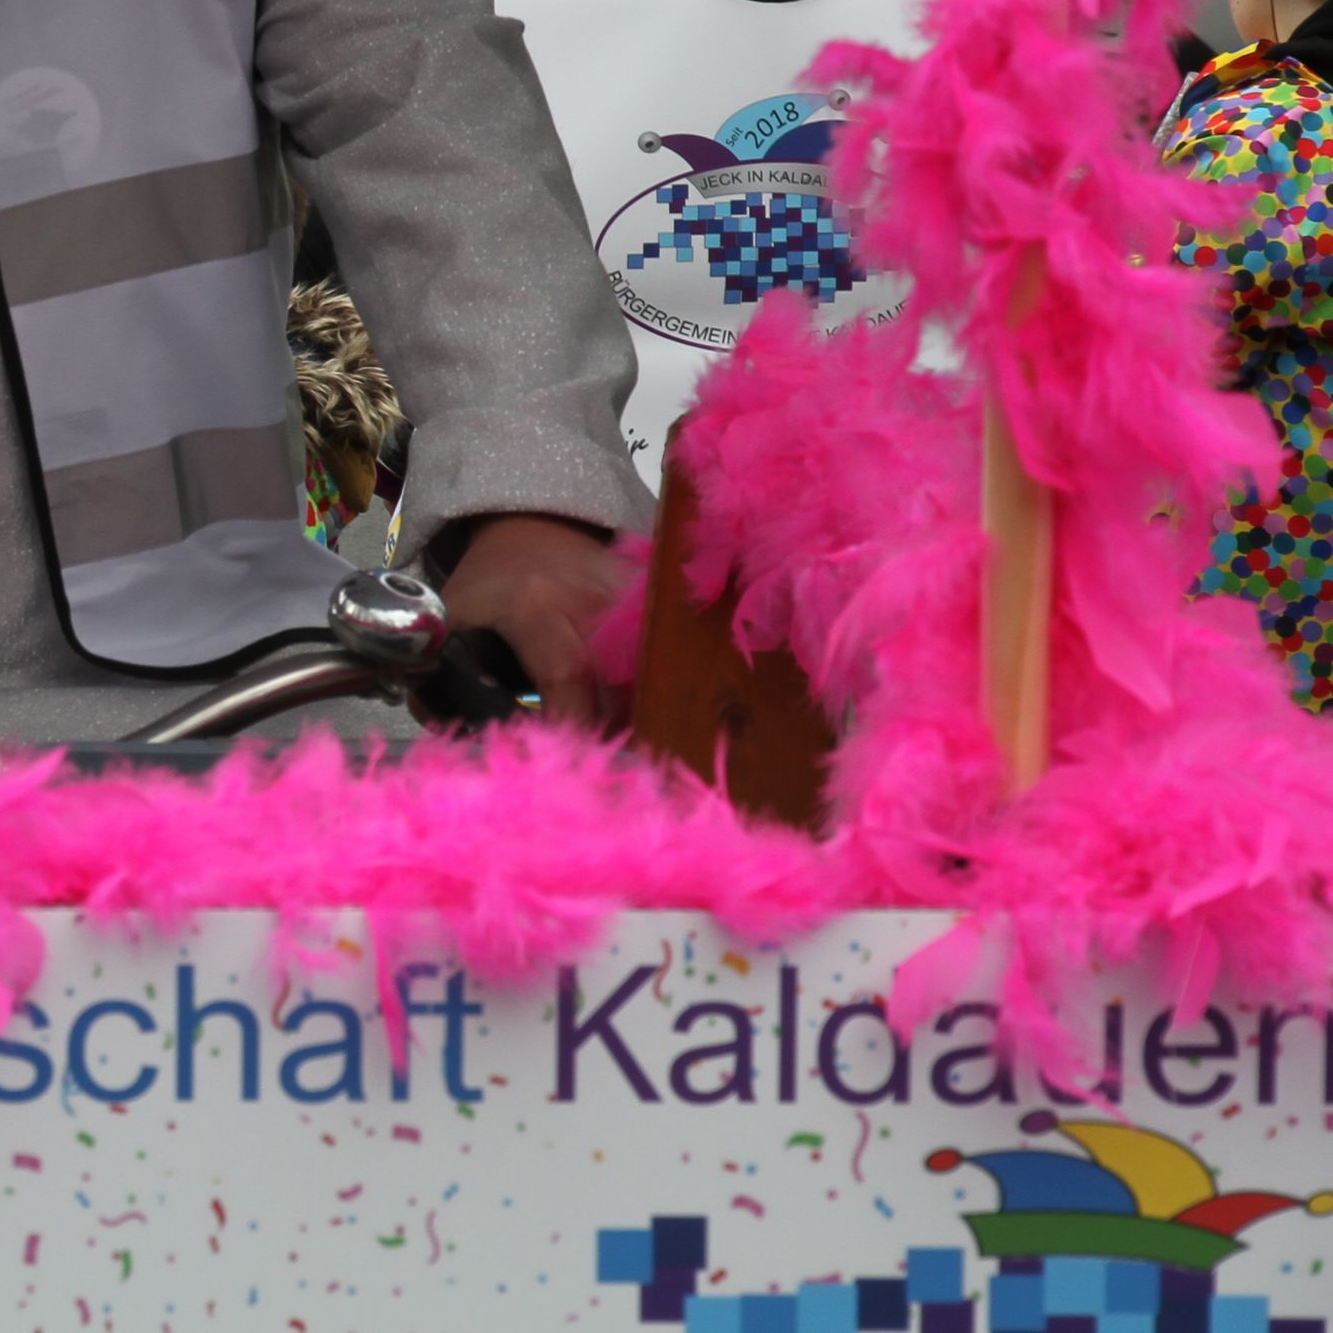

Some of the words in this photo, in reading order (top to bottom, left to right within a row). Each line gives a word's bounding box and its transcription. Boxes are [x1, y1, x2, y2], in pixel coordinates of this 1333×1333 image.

[744, 101, 800, 150] 2018
[699, 173, 743, 192] JECK
[747, 170, 764, 183] IN
[769, 169, 828, 188] KALDA
[555, 963, 1333, 1106] Kaldauen
